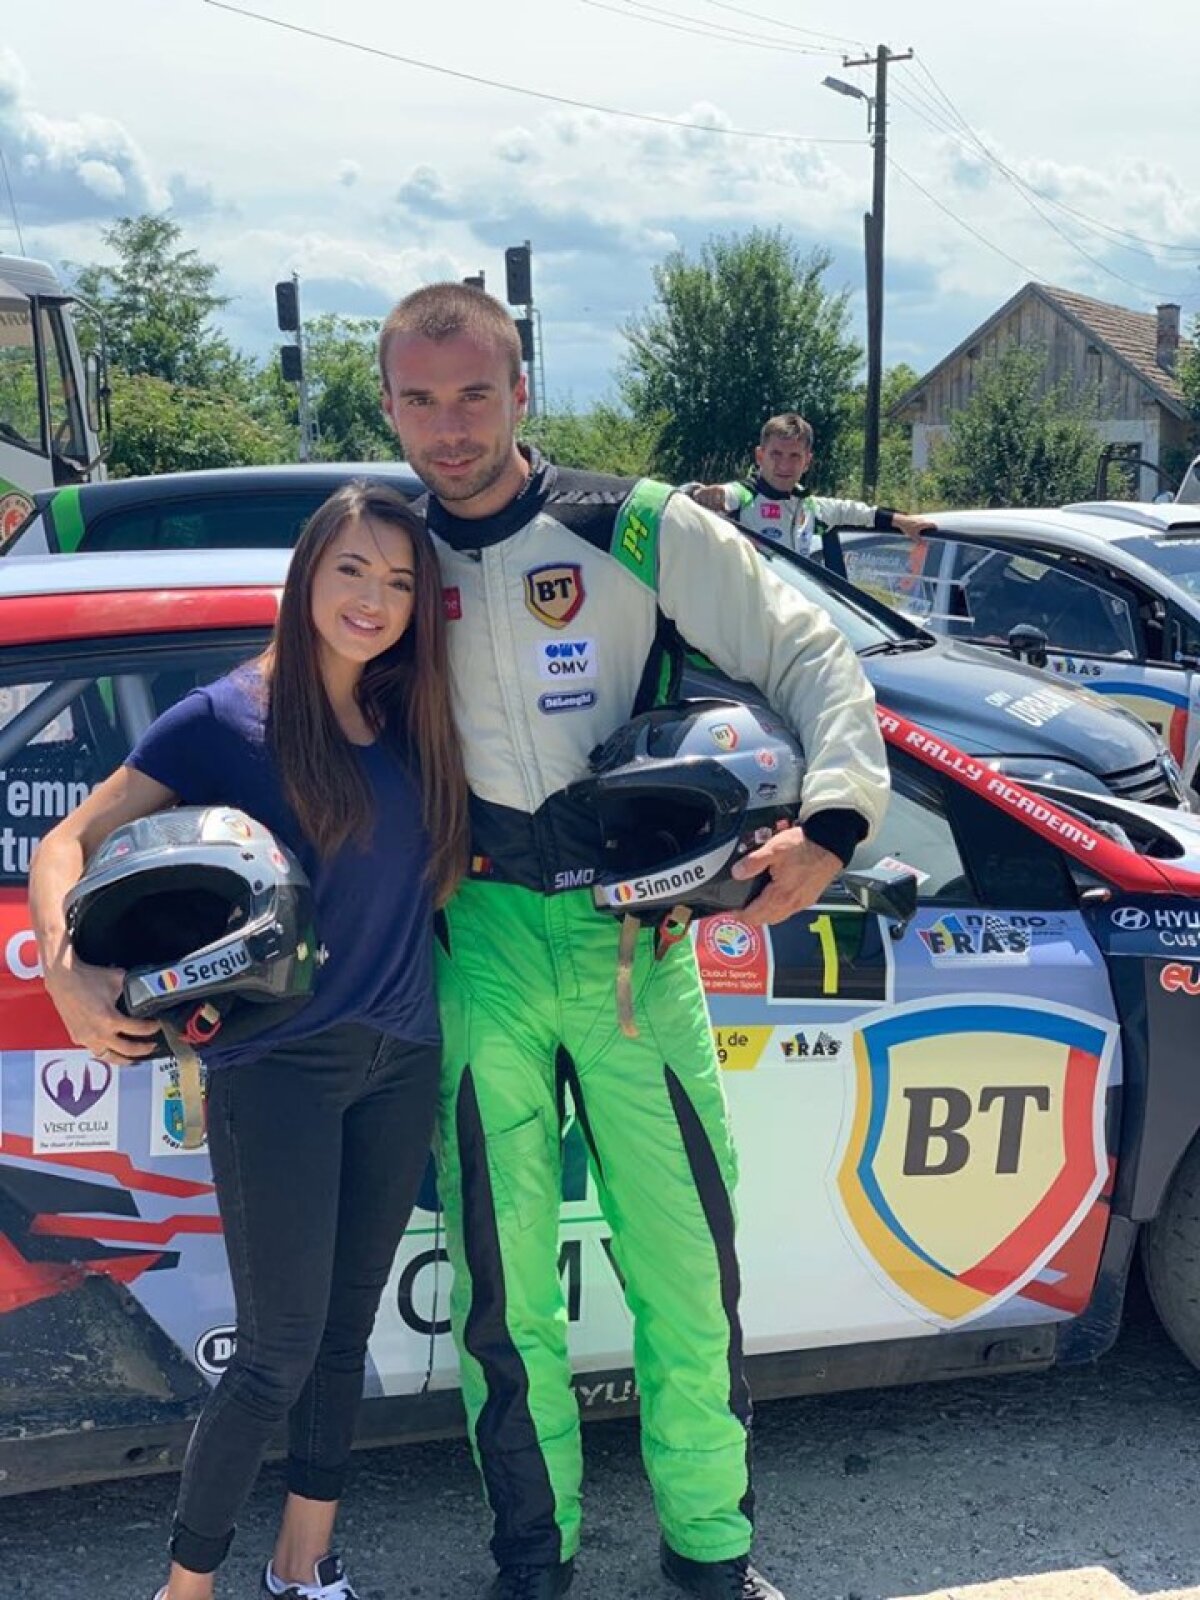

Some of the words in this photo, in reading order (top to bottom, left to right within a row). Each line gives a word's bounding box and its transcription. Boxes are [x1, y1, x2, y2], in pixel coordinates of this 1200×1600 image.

[536, 576, 573, 602] BT
[547, 660, 588, 675] OMV
[905, 730, 983, 781] RALLY
[986, 777, 1098, 851] ACADEMY
[633, 864, 706, 899] Simone
[809, 914, 839, 994] 1
[929, 931, 1027, 954] FRAS
[183, 950, 248, 984] Sergiu
[727, 1031, 749, 1047] de
[783, 1041, 841, 1057] FRAS
[43, 1121, 75, 1133] VISIT
[78, 1121, 109, 1132] CLUJ
[902, 1085, 1051, 1176] BT
